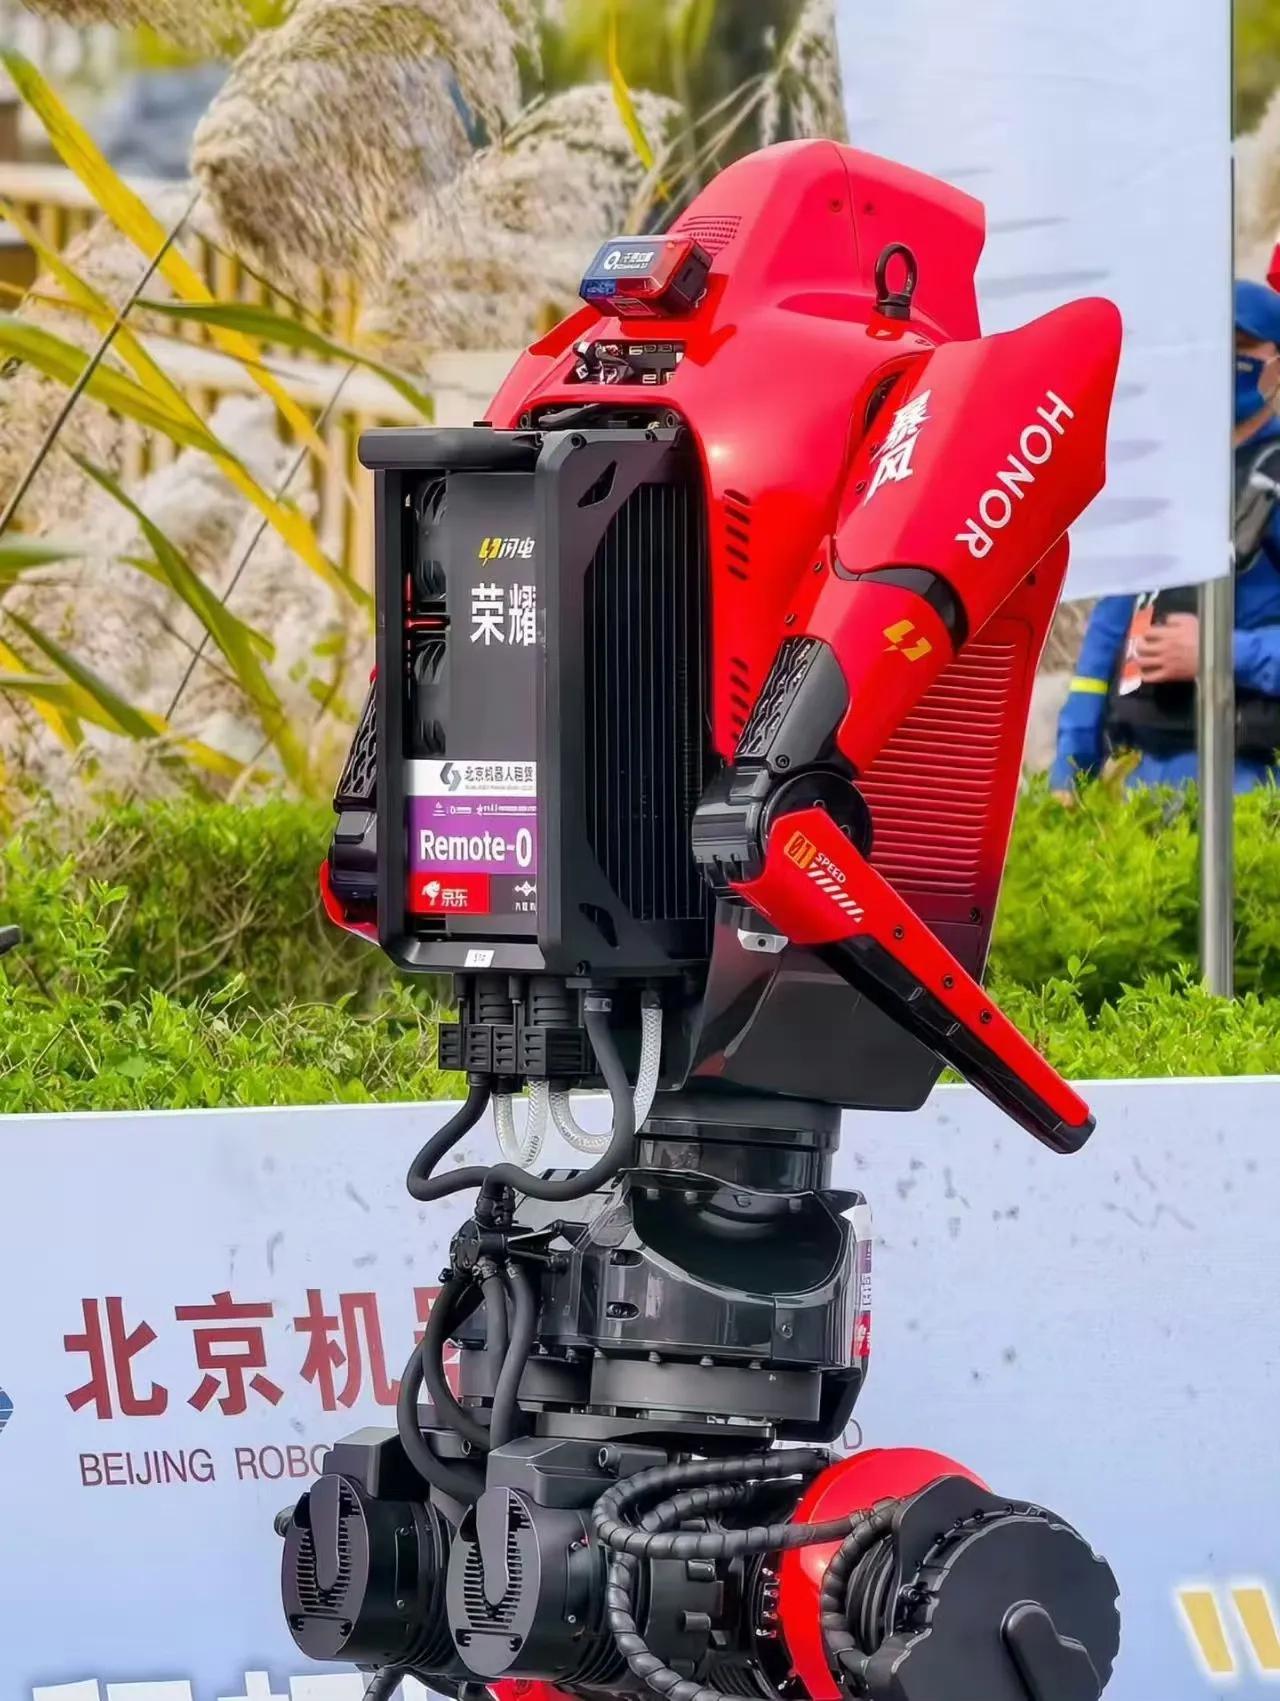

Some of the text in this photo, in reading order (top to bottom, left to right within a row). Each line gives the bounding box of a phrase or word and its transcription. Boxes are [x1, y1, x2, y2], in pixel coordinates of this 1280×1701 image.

[954, 390, 1075, 559] HONOR
[499, 536, 536, 559] 闪电
[470, 582, 537, 647] 荣耀
[815, 852, 847, 884] SPEED
[79, 1449, 216, 1487] BEIJING
